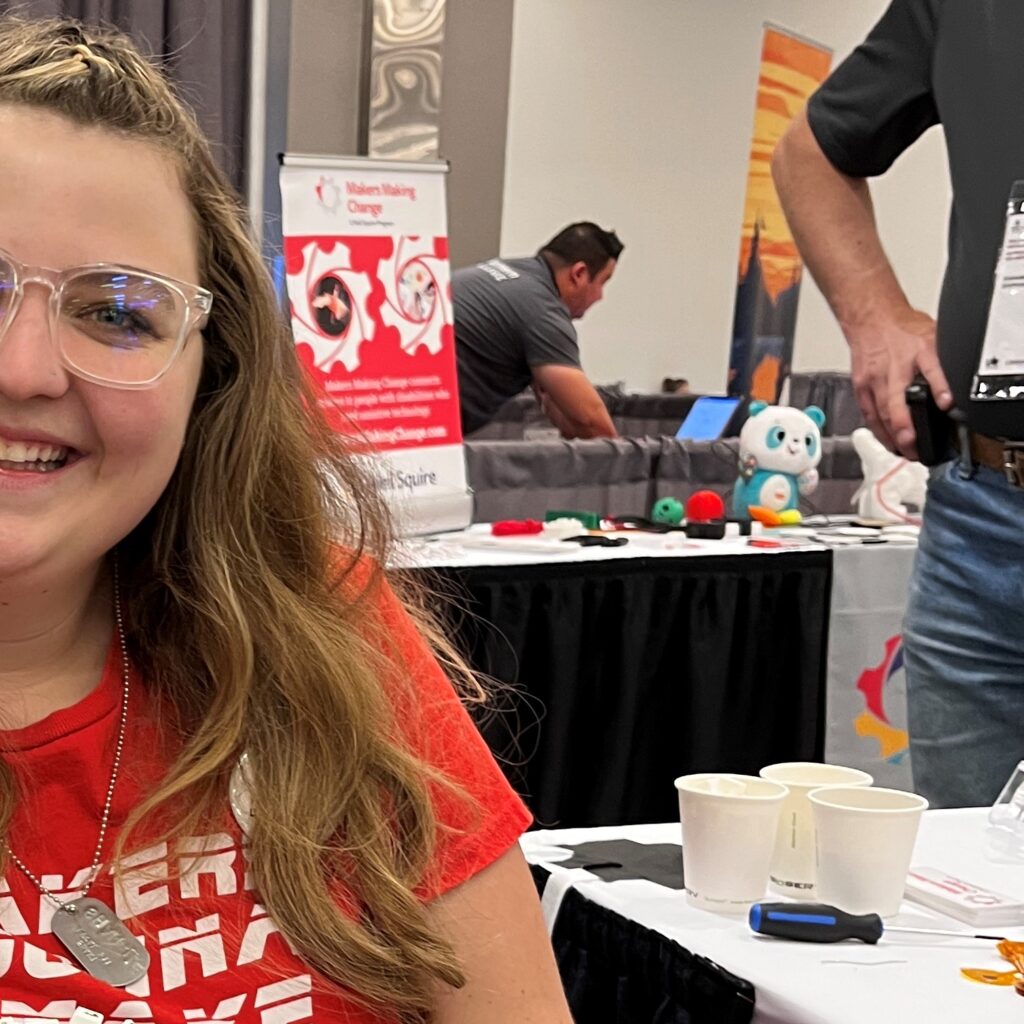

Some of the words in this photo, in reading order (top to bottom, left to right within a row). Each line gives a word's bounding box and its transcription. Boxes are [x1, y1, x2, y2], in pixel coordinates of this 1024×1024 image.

[346, 181, 380, 196] Makers
[381, 183, 416, 201] Making
[347, 199, 382, 218] Change
[396, 466, 437, 493] Squire
